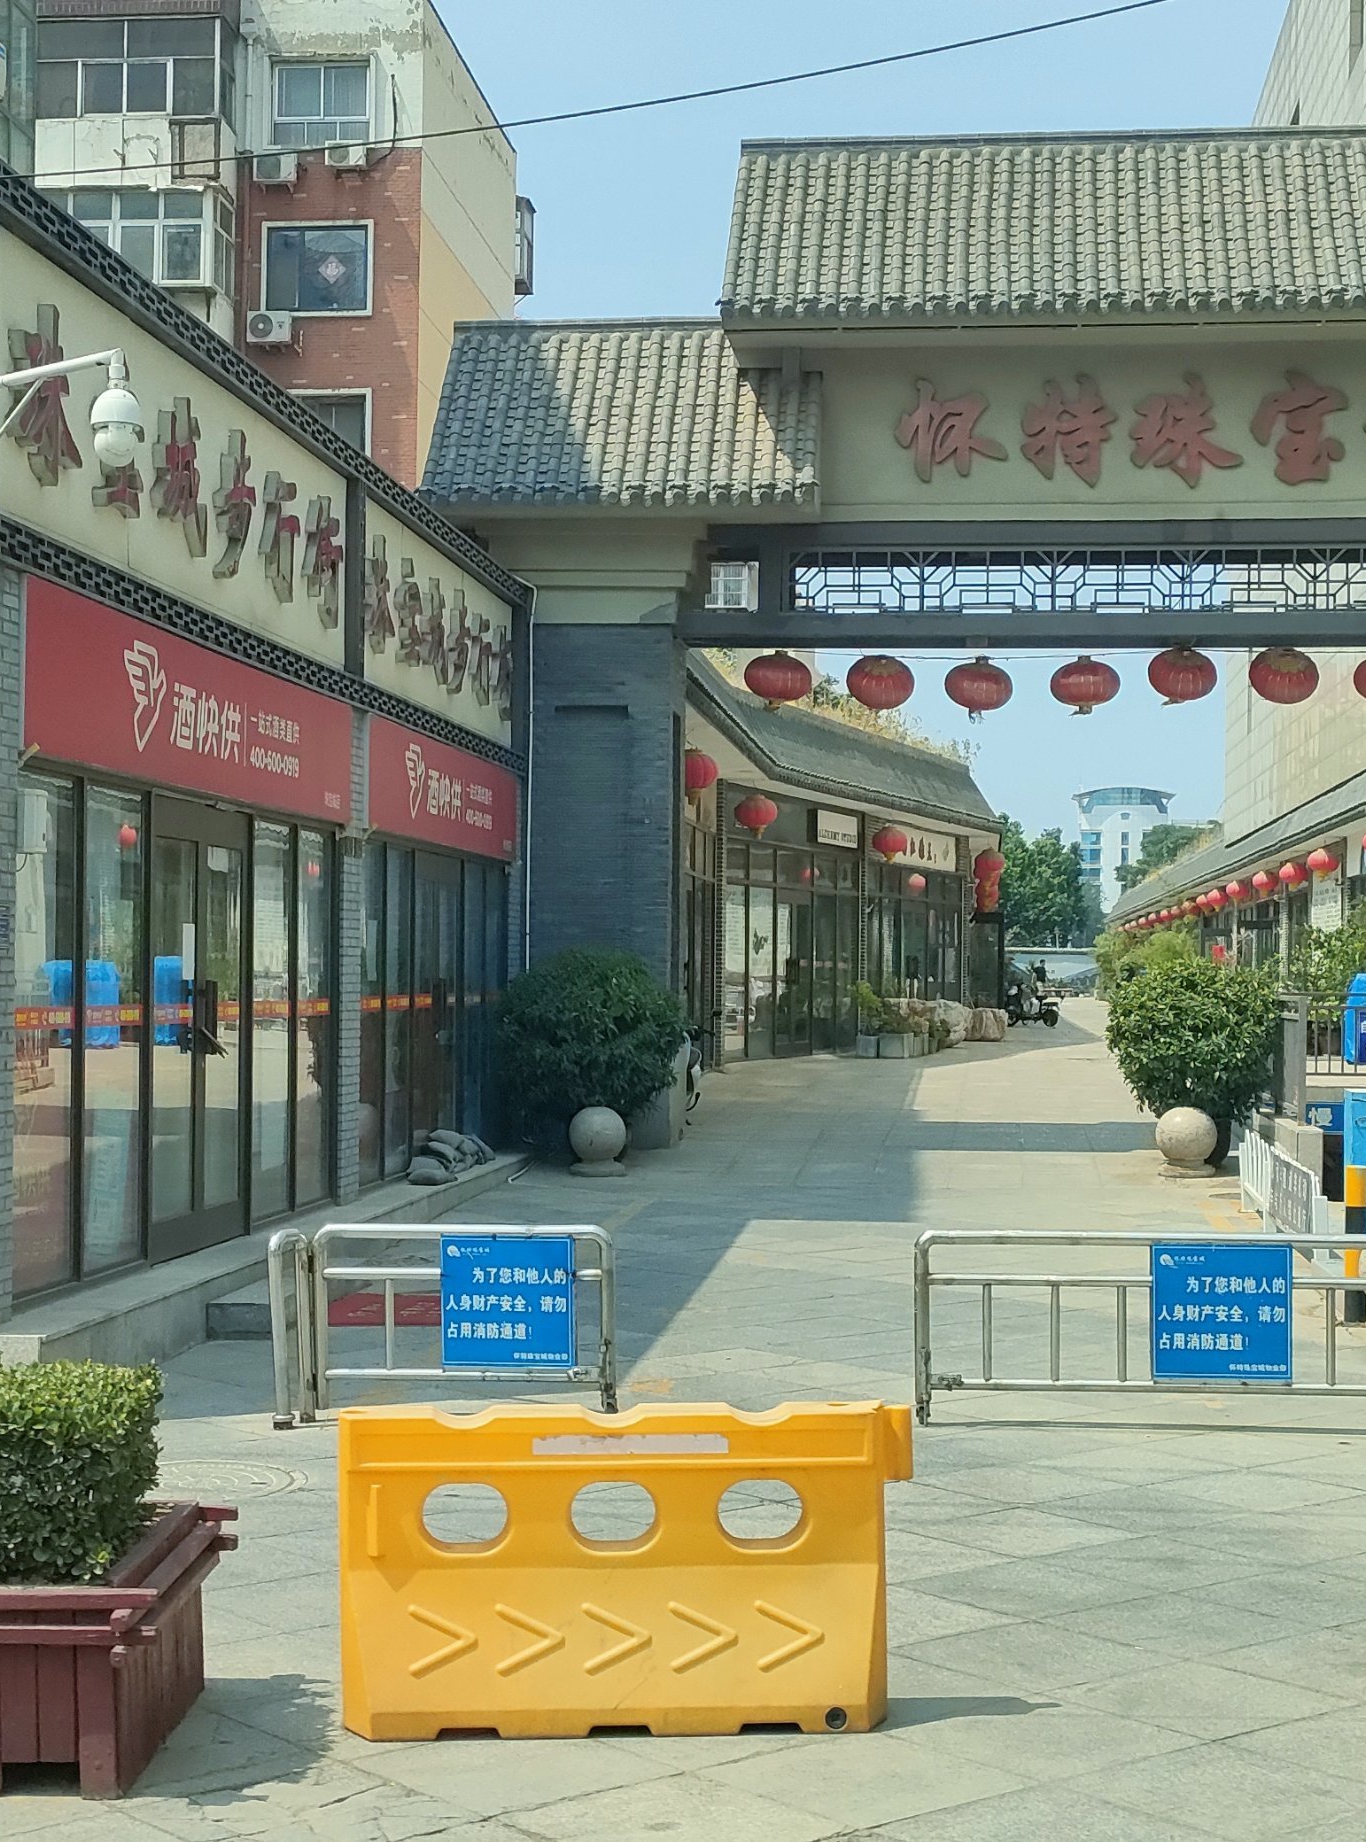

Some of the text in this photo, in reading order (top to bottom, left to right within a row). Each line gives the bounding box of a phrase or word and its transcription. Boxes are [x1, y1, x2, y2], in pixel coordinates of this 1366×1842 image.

[5, 304, 343, 629] 珠城步行街
[170, 682, 241, 764] 酒快供
[249, 745, 300, 778] 400-600-0919
[426, 768, 462, 822] 酒快供
[472, 1267, 566, 1285] 为了您和他人的
[1186, 1276, 1285, 1295] 为了您和他人的
[446, 1293, 567, 1313] 人身财产安全，请勿
[1158, 1304, 1286, 1323] 人身财产安全，请勿
[447, 1321, 532, 1340] 占用消防通道！
[1159, 1332, 1250, 1351] 占用消防通道！
